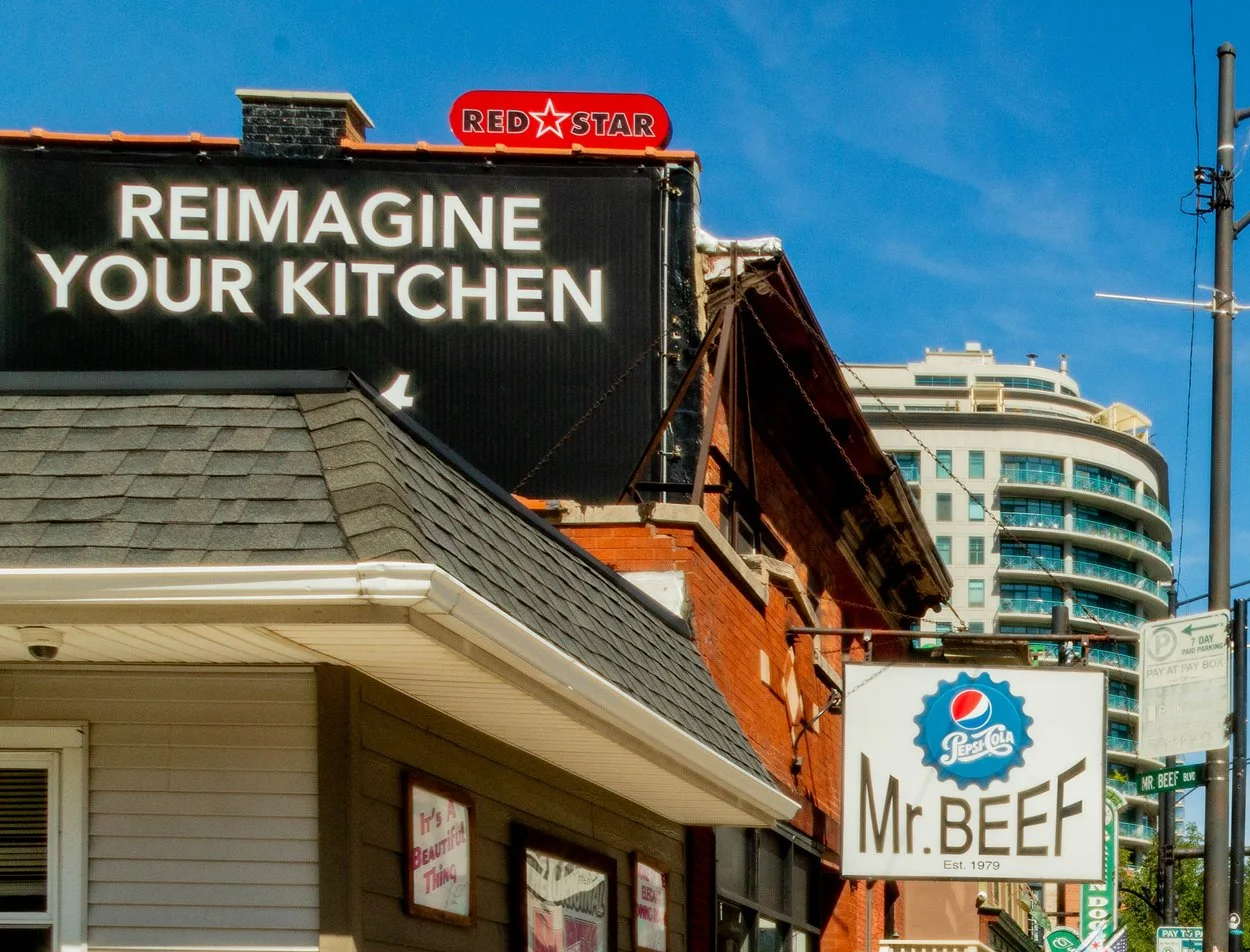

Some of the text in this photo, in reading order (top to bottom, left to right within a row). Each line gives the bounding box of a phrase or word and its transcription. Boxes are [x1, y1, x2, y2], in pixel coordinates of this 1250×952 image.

[462, 108, 656, 137] RED STAR
[119, 184, 542, 251] REIMAGINE
[36, 253, 603, 323] YOUR KITCHEN
[1190, 634, 1214, 646] 7 DAY
[1197, 643, 1224, 653] PARKING
[1147, 659, 1224, 678] PAY AT PAY BOX
[1141, 770, 1196, 791] MR. BEEF BLVD
[446, 799, 456, 822] A
[858, 751, 1087, 857] Mr. BEEF
[943, 860, 1000, 871] Est. 1979
[1162, 930, 1179, 938] PAY
[1181, 930, 1193, 938] TO
